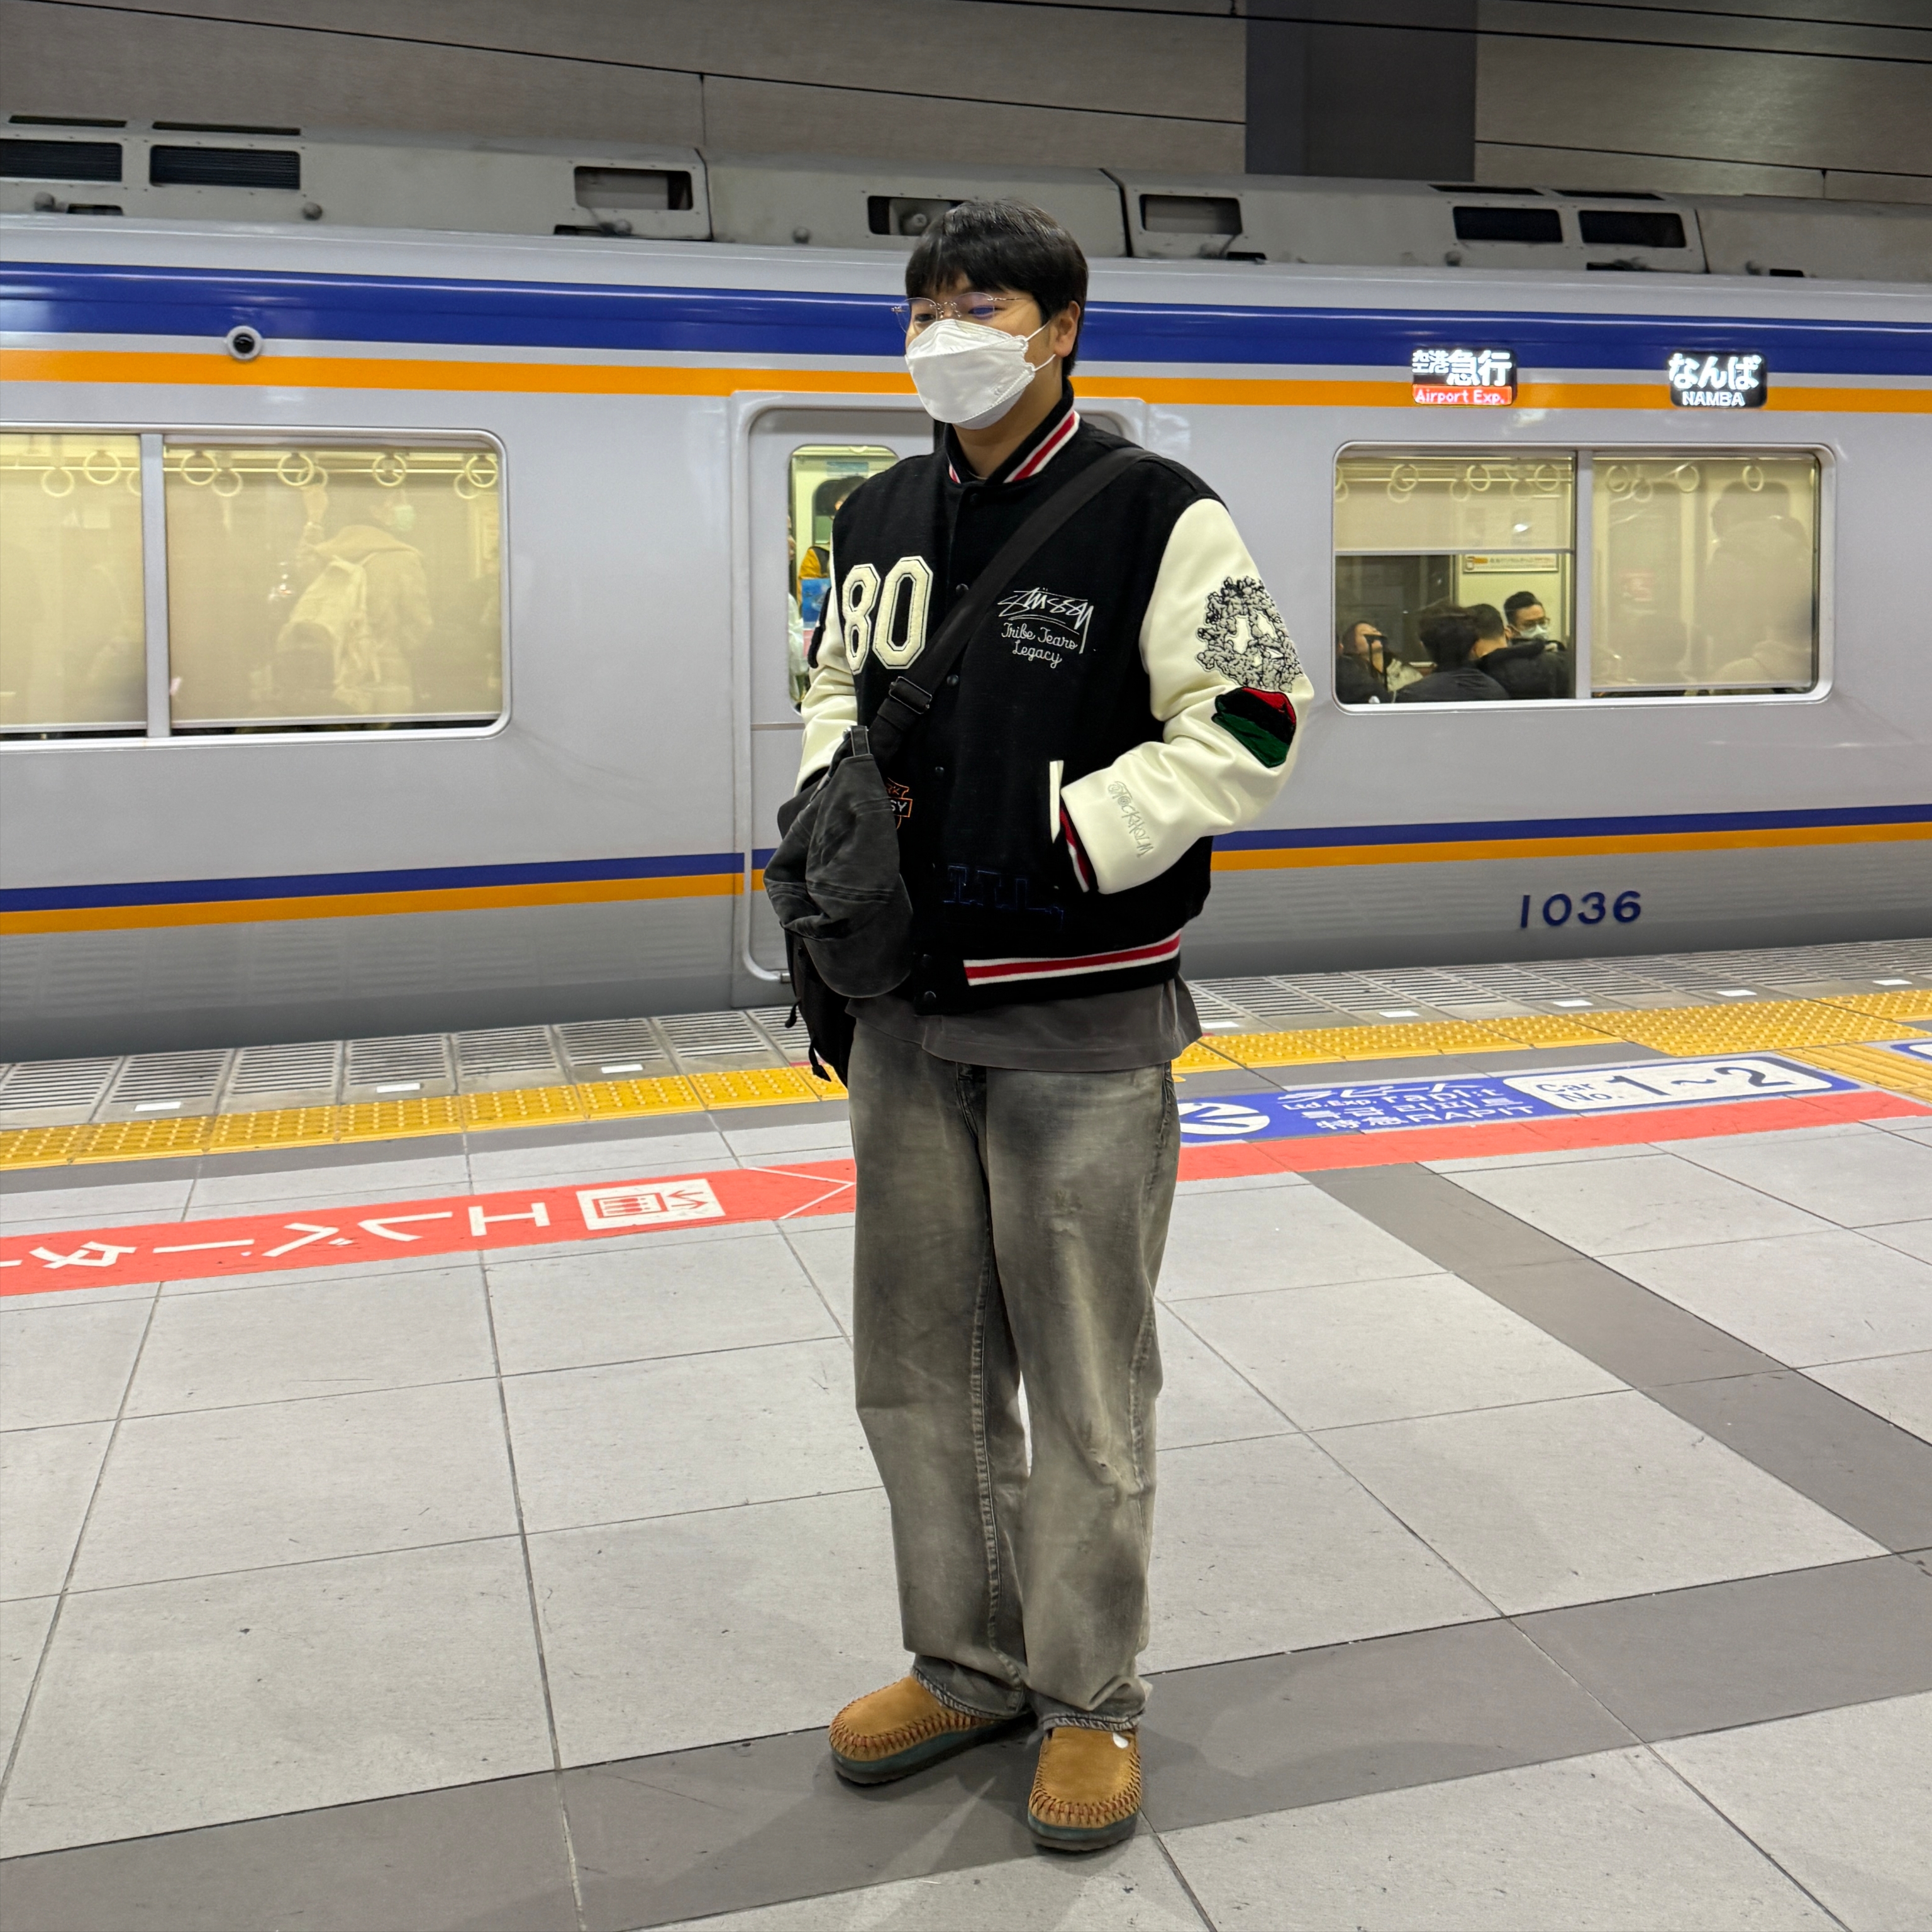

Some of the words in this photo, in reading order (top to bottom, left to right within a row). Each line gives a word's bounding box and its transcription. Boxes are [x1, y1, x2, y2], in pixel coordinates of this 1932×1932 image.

[1412, 349, 1512, 386] 空港急行
[1668, 353, 1762, 390] なんば
[1415, 389, 1468, 404] Airport
[1474, 389, 1505, 405] Exp.
[1682, 391, 1745, 406] NAMBA
[842, 556, 933, 675] 80
[1001, 623, 1036, 639] Tribe
[1038, 627, 1078, 650] Tears
[1012, 640, 1062, 669] Legacy
[1520, 890, 1641, 929] 1036
[1277, 1083, 1483, 1104] ラピート
[1536, 1083, 1594, 1093] Car
[1557, 1093, 1624, 1102] No.
[0, 1201, 550, 1269] エレベータ
